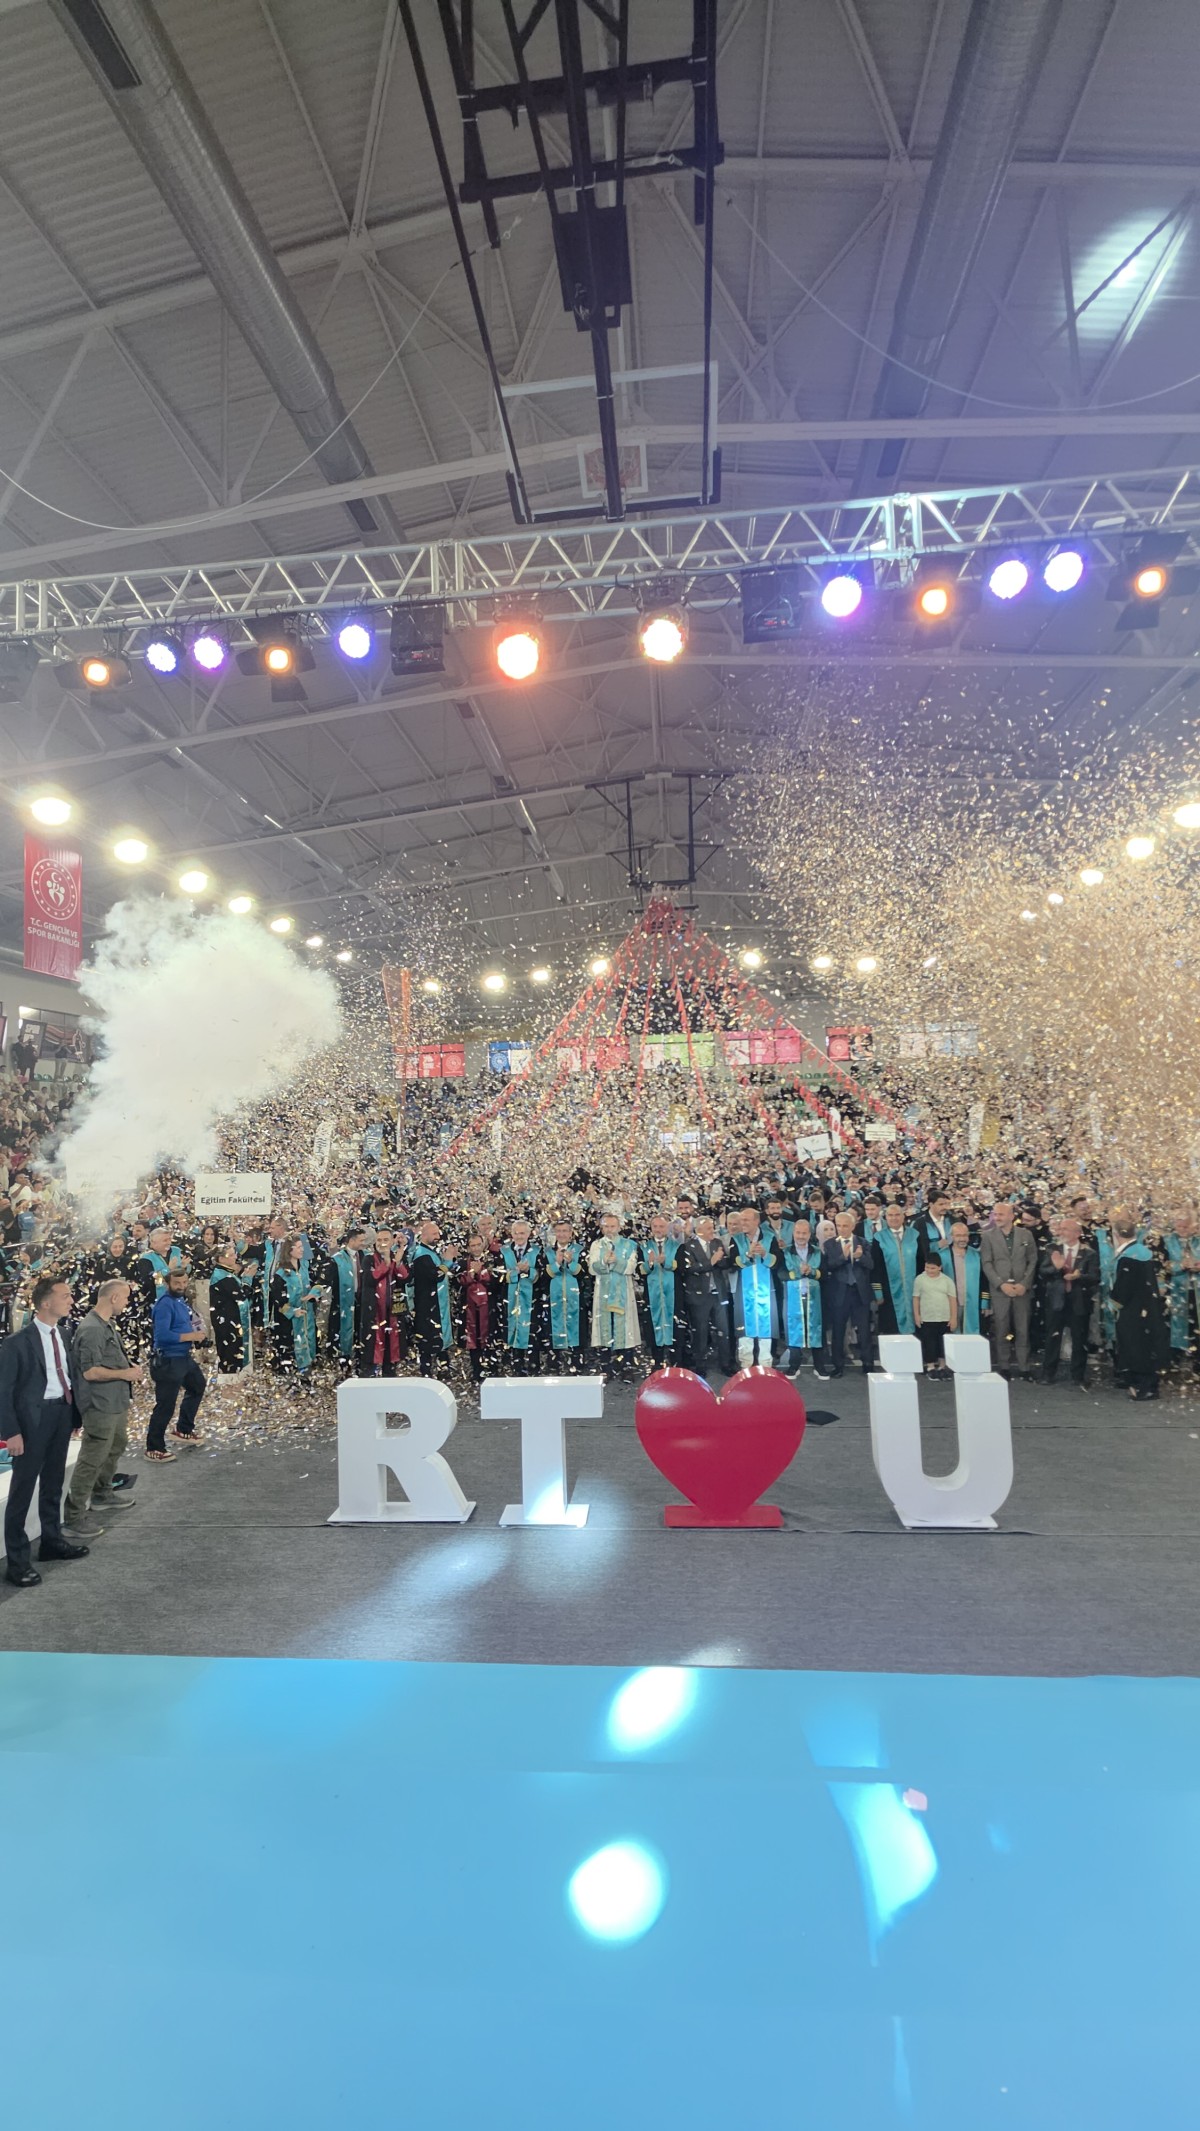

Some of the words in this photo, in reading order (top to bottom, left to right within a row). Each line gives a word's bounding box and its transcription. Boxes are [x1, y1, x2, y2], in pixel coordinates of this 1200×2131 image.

[27, 926, 47, 938] SPOR
[30, 917, 42, 927] T.C.
[70, 930, 78, 939] VE
[200, 1196, 226, 1205] Eğitim
